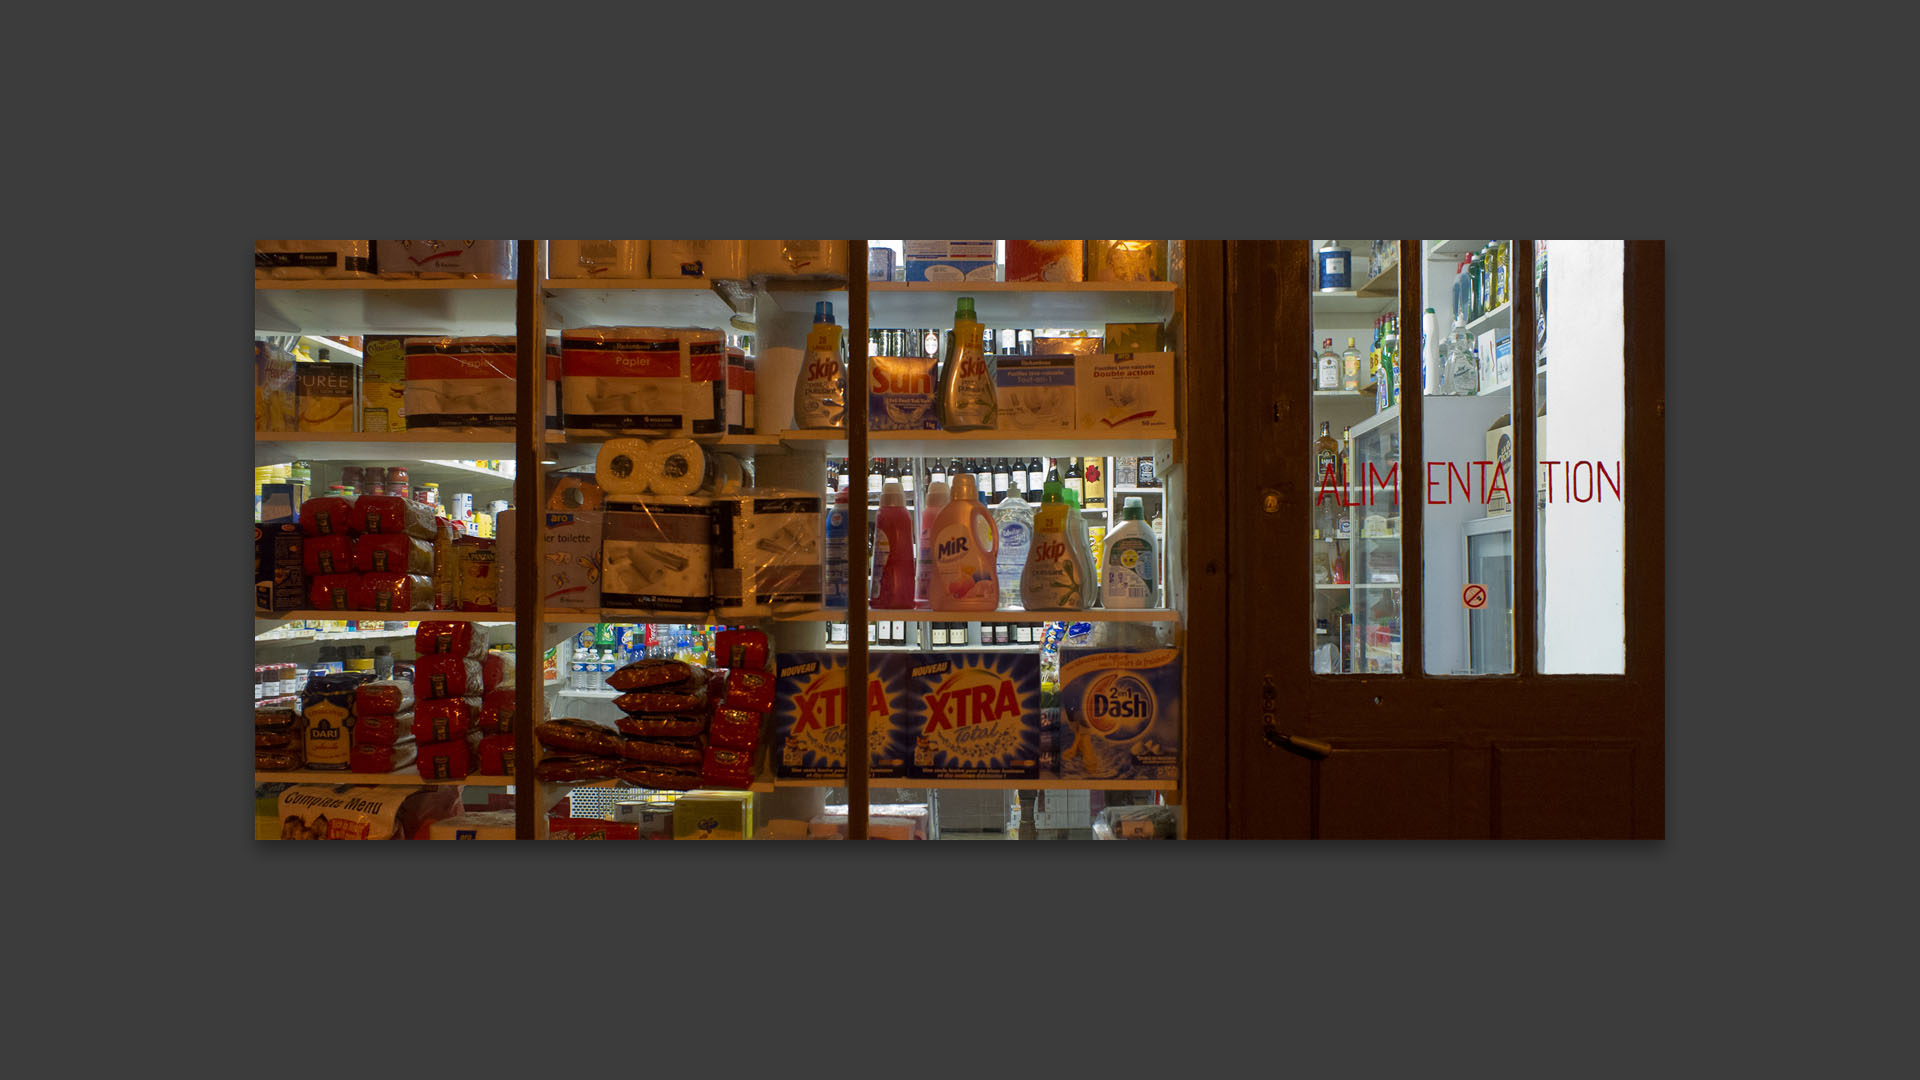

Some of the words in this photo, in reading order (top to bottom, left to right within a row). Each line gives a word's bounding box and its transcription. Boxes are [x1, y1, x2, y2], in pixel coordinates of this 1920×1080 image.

[615, 356, 650, 368] Papier
[807, 357, 839, 382] skip
[960, 357, 986, 380] skip
[872, 367, 931, 393] Sun
[1093, 370, 1125, 378] Double
[551, 514, 568, 523] aro
[558, 533, 591, 543] toilette
[1034, 540, 1066, 563] skip
[780, 662, 817, 678] NOUVEAU
[912, 662, 948, 678] NOUVEAU
[1094, 694, 1147, 718] Dash
[312, 729, 338, 738] DARI
[344, 797, 383, 815] Menu
